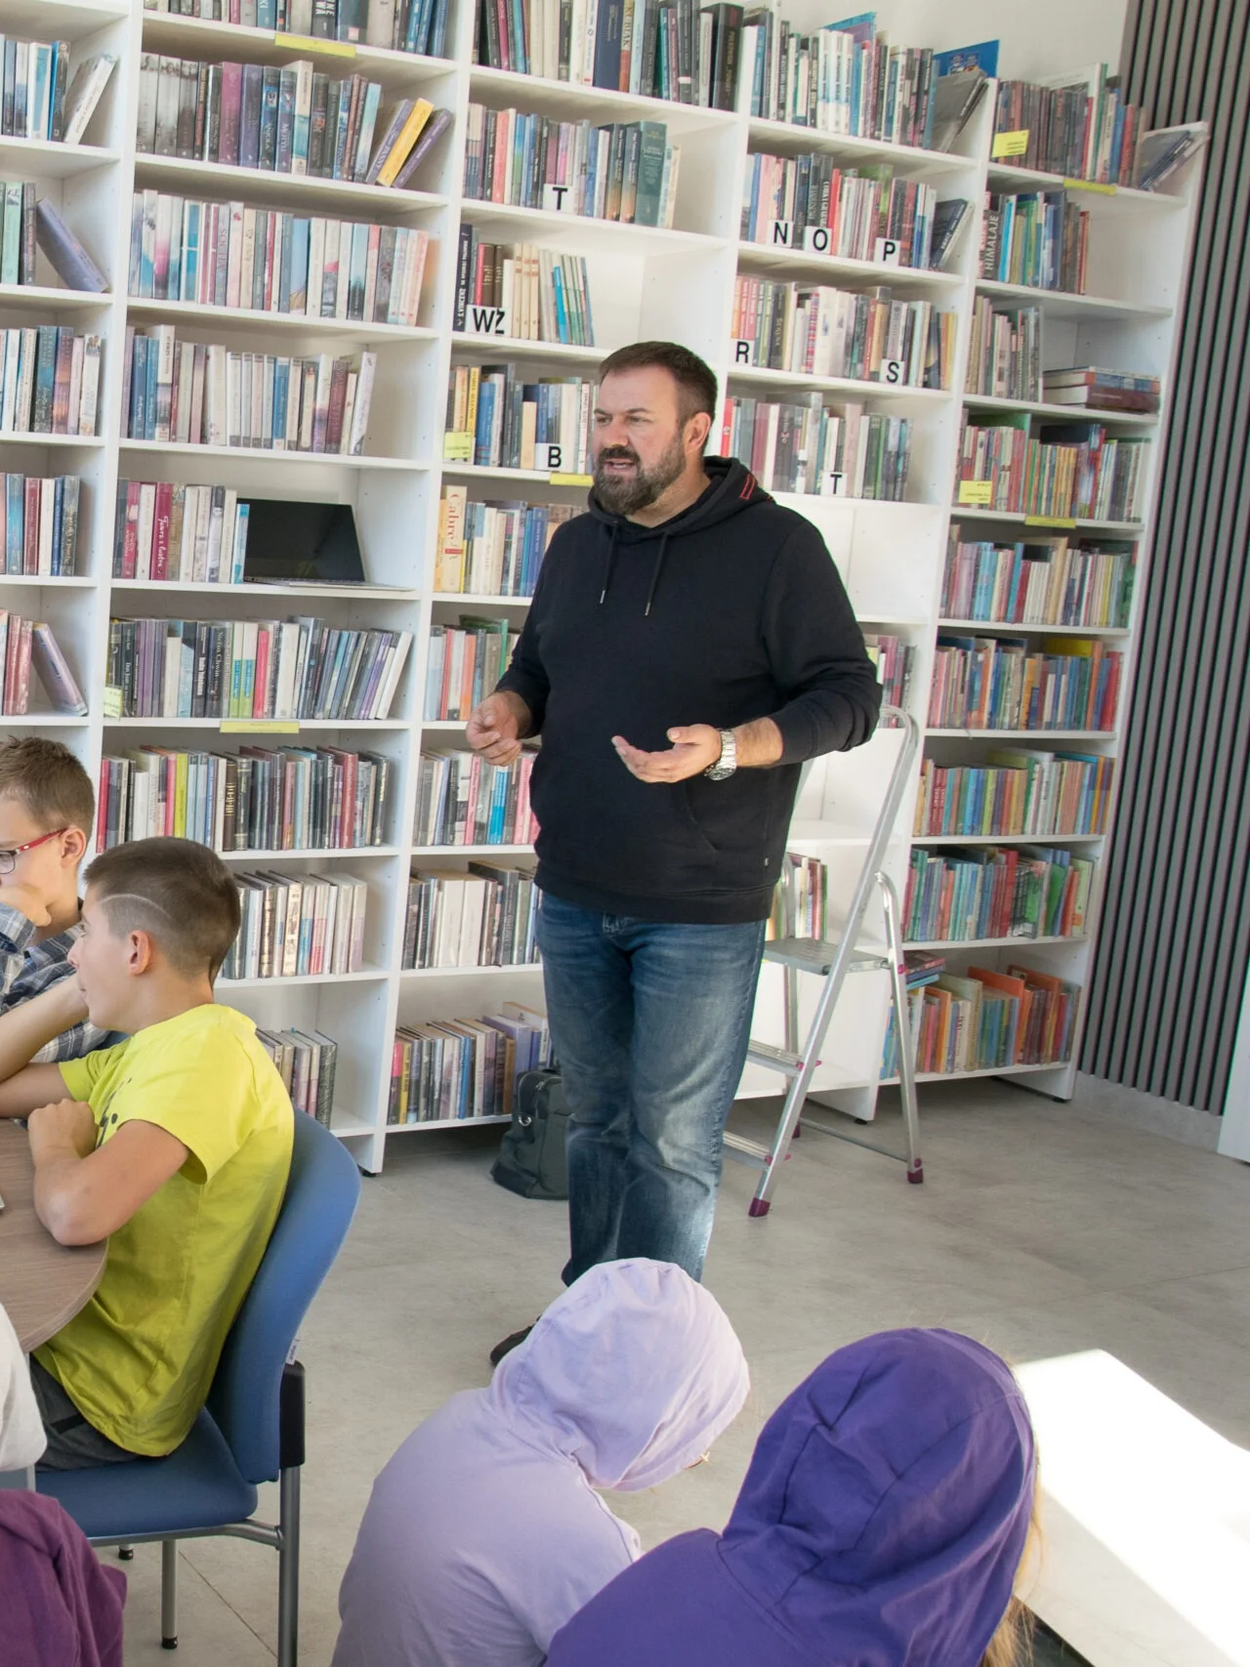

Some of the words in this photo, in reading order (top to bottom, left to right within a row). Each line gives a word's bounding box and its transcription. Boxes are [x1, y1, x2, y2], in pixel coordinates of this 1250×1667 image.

[623, 6, 632, 46] KUBIAK
[553, 187, 567, 210] T
[774, 222, 788, 244] N
[813, 228, 827, 251] O
[985, 216, 999, 270] HIMALAJE
[218, 227, 227, 269] SOCHA
[882, 241, 895, 261] P
[473, 308, 494, 333] W
[736, 341, 749, 364] R
[886, 361, 900, 384] S
[548, 445, 561, 468] B
[830, 473, 842, 494] T
[158, 516, 168, 539] Twarz
[158, 546, 166, 566] lustra
[215, 631, 224, 652] Stefan
[214, 654, 222, 677] Chwin
